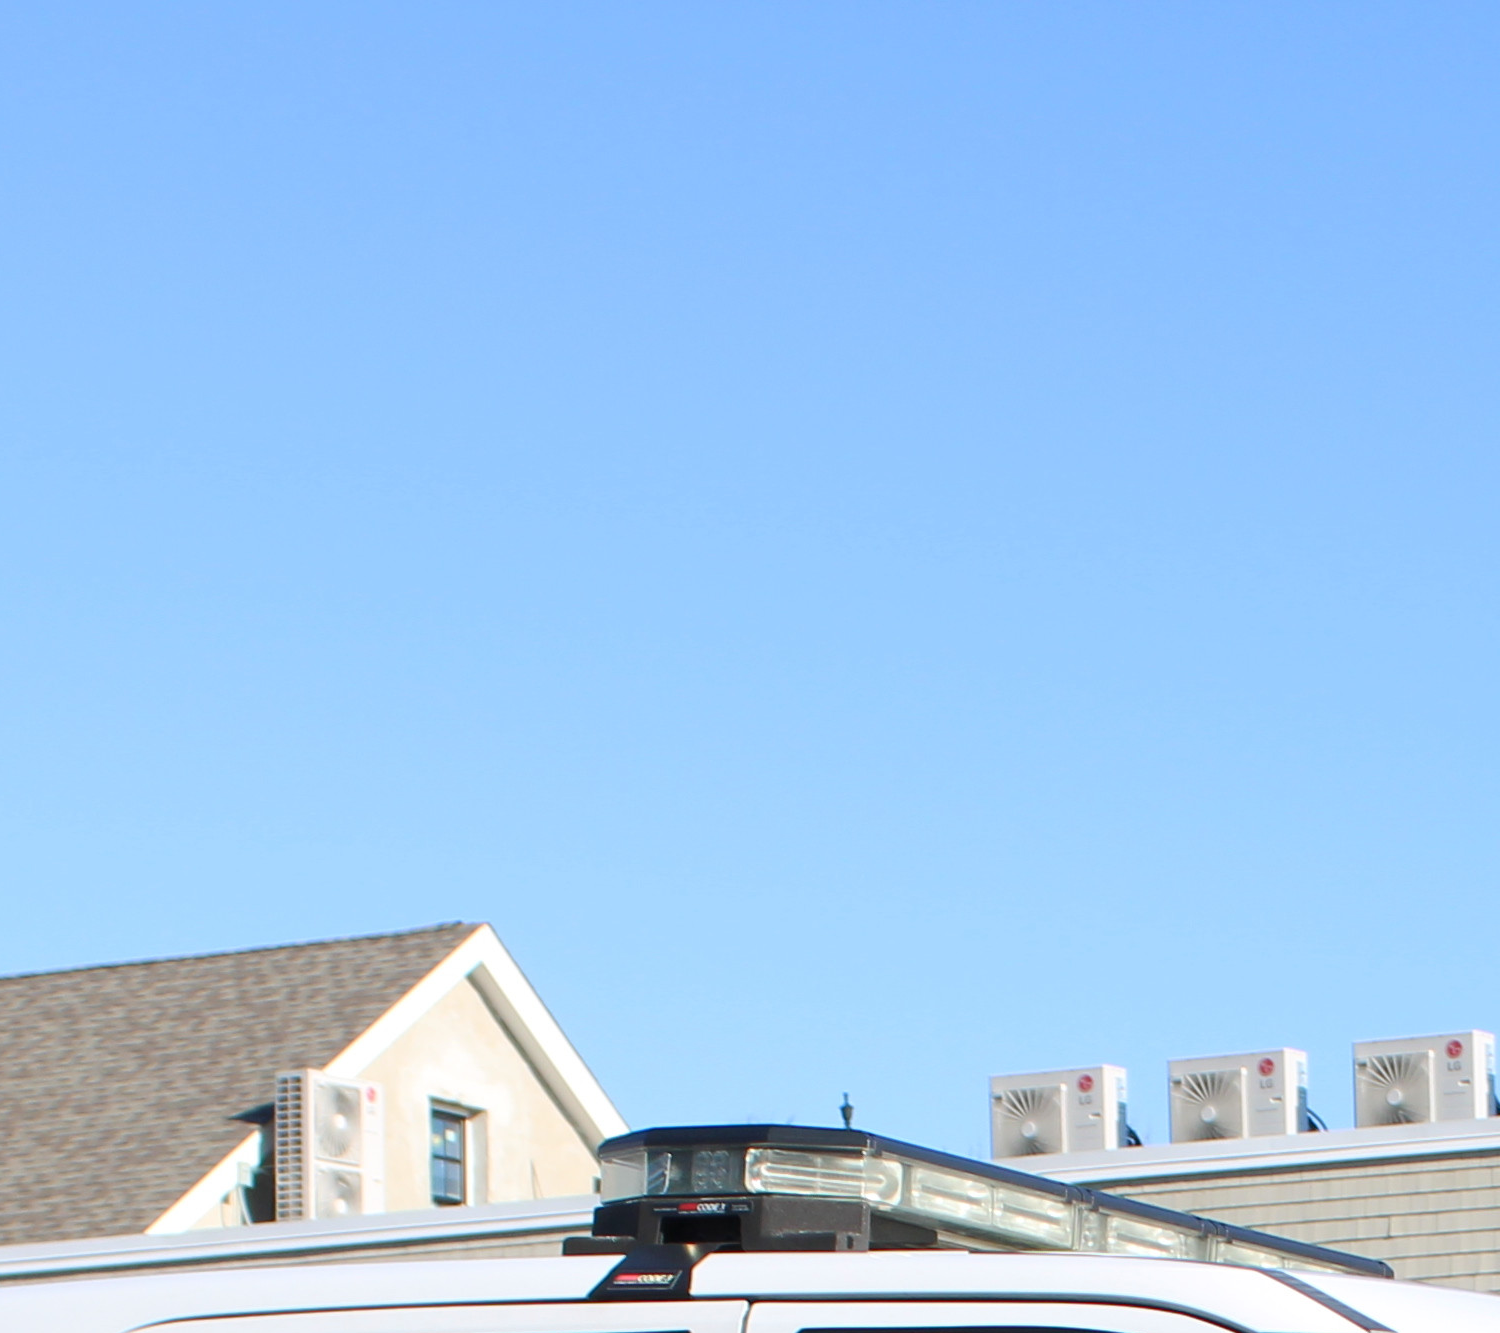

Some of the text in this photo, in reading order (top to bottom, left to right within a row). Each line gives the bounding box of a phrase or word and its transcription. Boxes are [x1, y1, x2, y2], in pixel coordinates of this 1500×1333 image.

[1447, 1061, 1462, 1072] LG
[1259, 1078, 1273, 1089] LG
[1078, 1095, 1092, 1106] LG
